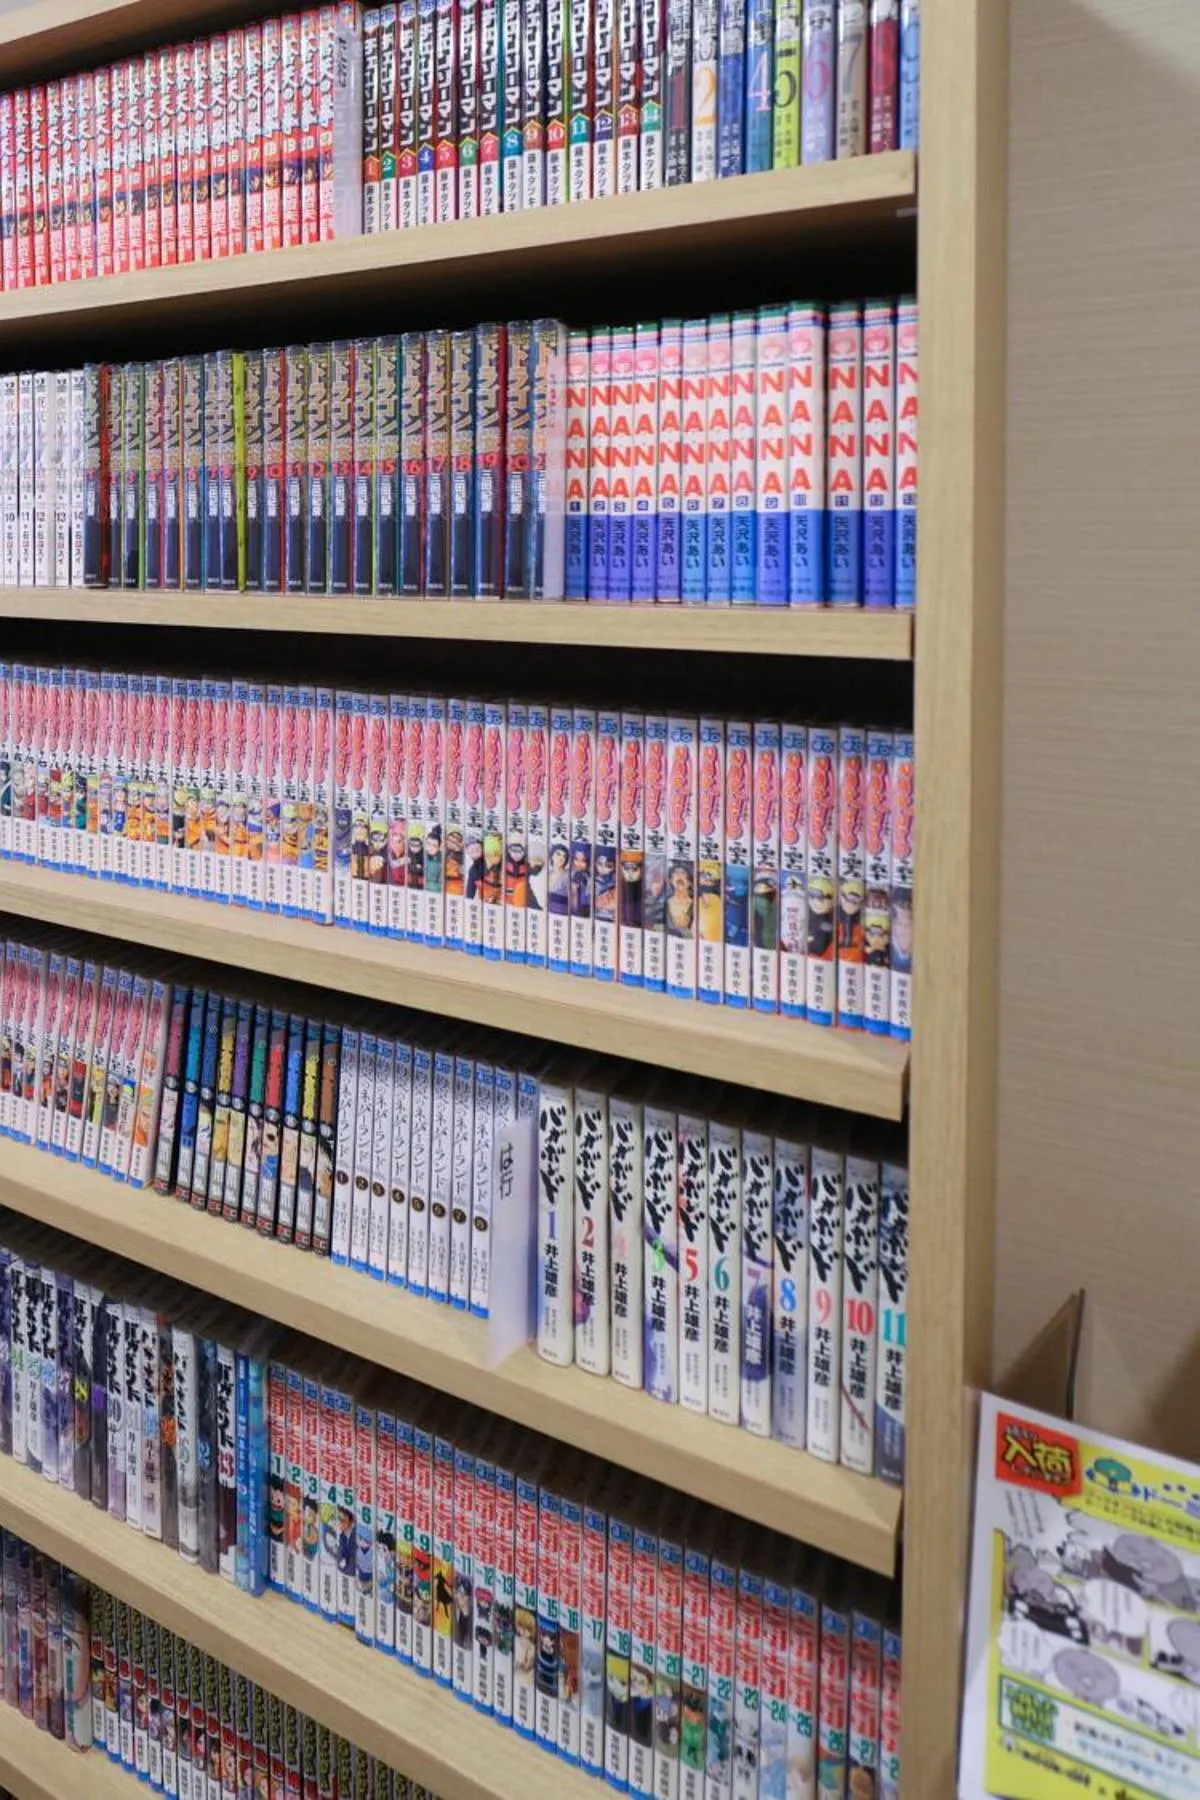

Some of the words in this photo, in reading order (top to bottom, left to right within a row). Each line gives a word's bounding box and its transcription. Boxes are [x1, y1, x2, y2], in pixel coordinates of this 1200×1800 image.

[843, 33, 864, 95] 7
[748, 50, 771, 111] 4
[694, 67, 717, 127] 2
[573, 121, 586, 134] 11
[596, 117, 612, 130] 12
[620, 115, 636, 127] 13
[643, 109, 658, 121] 14
[484, 137, 494, 150] 7
[507, 135, 518, 147] 8
[526, 128, 538, 140] 9
[549, 128, 564, 141] 10
[383, 159, 391, 171] 2
[402, 156, 412, 168] 3
[421, 151, 430, 162] 4
[440, 148, 450, 161] 5
[462, 146, 473, 158] 6
[367, 163, 374, 175] 1
[634, 382, 655, 496] NANA
[660, 378, 681, 494] NANA
[683, 379, 705, 496] NANA
[708, 375, 731, 494] NANA
[731, 371, 755, 492] NANA
[761, 370, 784, 494] NANA
[789, 365, 812, 490] NANA
[830, 365, 855, 491] NANA
[864, 364, 889, 491] NANA
[566, 386, 587, 498] NANA
[591, 385, 611, 498] NANA
[610, 384, 632, 498] NANA
[548, 1211, 556, 1240] 1
[581, 1216, 594, 1248] 2
[685, 1248, 698, 1281] 5
[714, 1255, 729, 1292] 6
[747, 1268, 762, 1294] 7
[779, 1279, 796, 1312] 8
[815, 1288, 832, 1324] 9
[846, 1299, 875, 1336] 10
[882, 1308, 908, 1346] 11
[274, 1456, 281, 1473] 1
[292, 1466, 301, 1484] 2
[309, 1477, 317, 1494] 3
[327, 1486, 336, 1503] 4
[343, 1488, 353, 1505] 5
[362, 1506, 371, 1524] 6
[384, 1514, 394, 1532] 7
[404, 1524, 414, 1542] 8
[420, 1535, 430, 1552] 9
